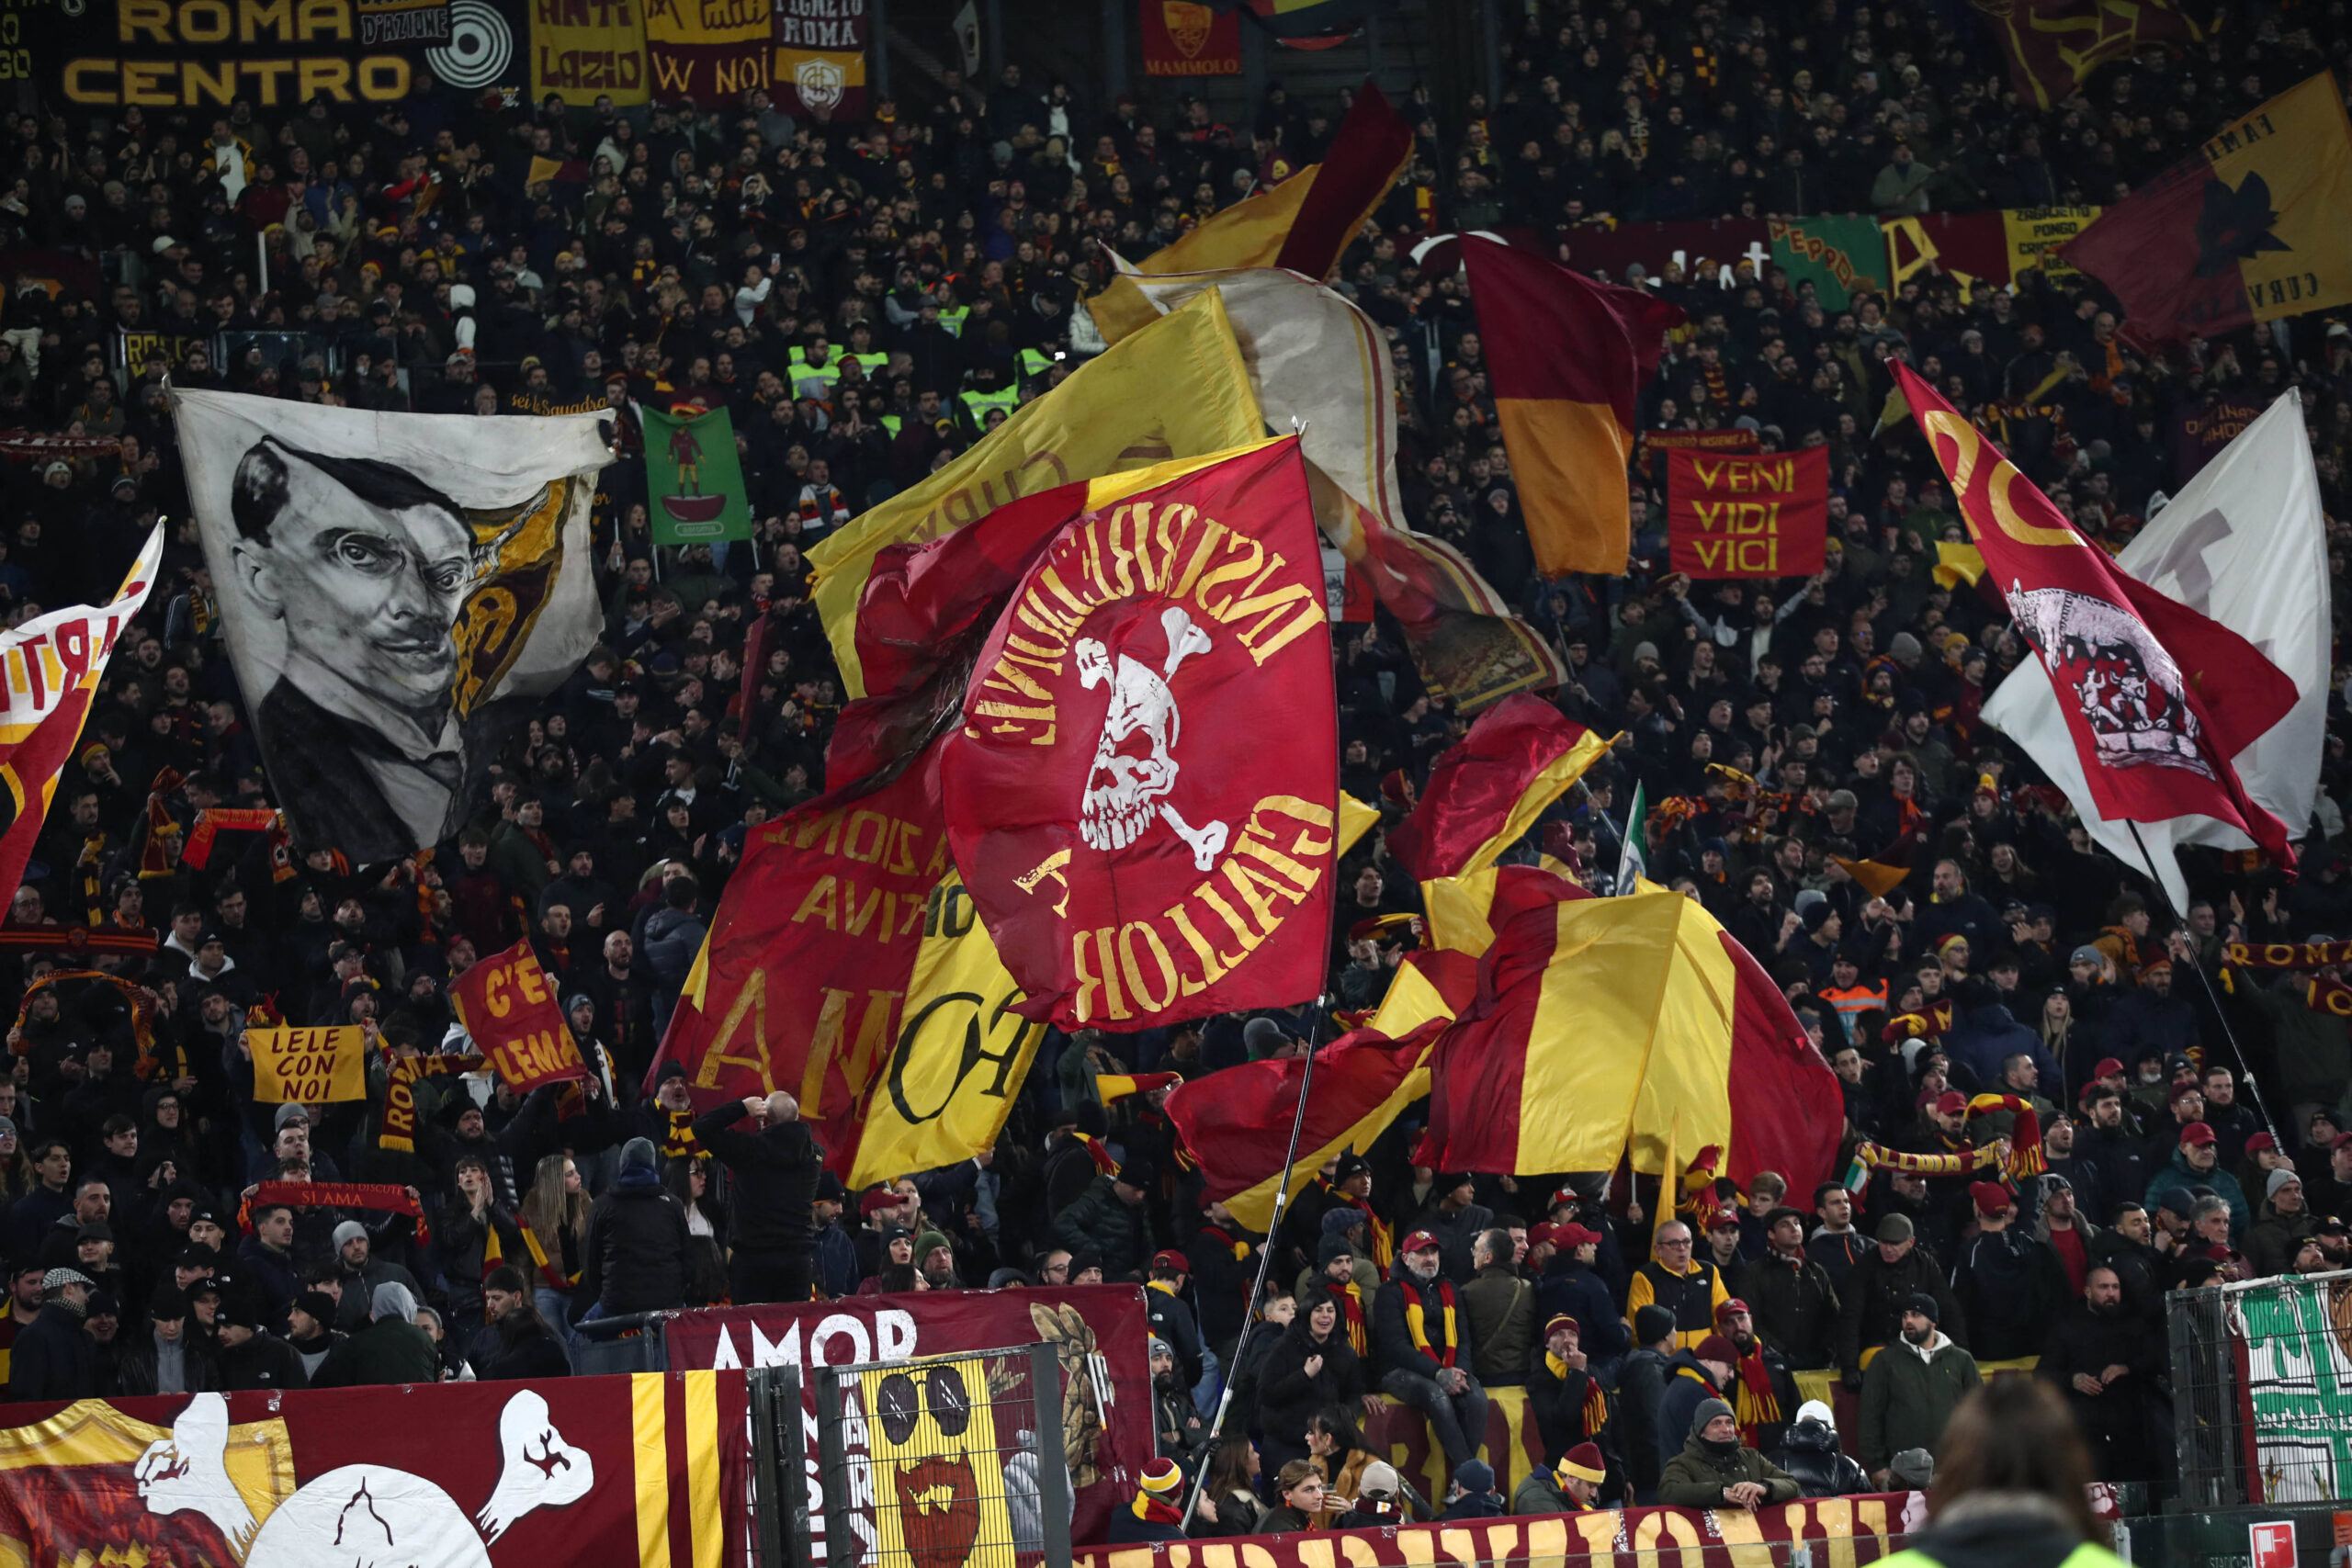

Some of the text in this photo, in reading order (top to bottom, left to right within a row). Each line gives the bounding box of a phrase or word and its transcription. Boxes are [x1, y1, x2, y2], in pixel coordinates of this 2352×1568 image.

[119, 0, 351, 43] ROMA
[783, 17, 858, 47] ROMA
[62, 55, 412, 107] CENTRO
[1146, 60, 1239, 75] MAMMOLO
[1692, 458, 1794, 493] VENI
[1690, 500, 1781, 535] VIDI
[1692, 537, 1779, 572] VICI
[272, 1029, 341, 1055] LELE
[277, 1054, 334, 1077] CON
[283, 1079, 331, 1101] NOI
[388, 1056, 448, 1132] ROMA
[302, 1190, 363, 1206] SI AMA
[358, 1183, 403, 1197] DISCUTE
